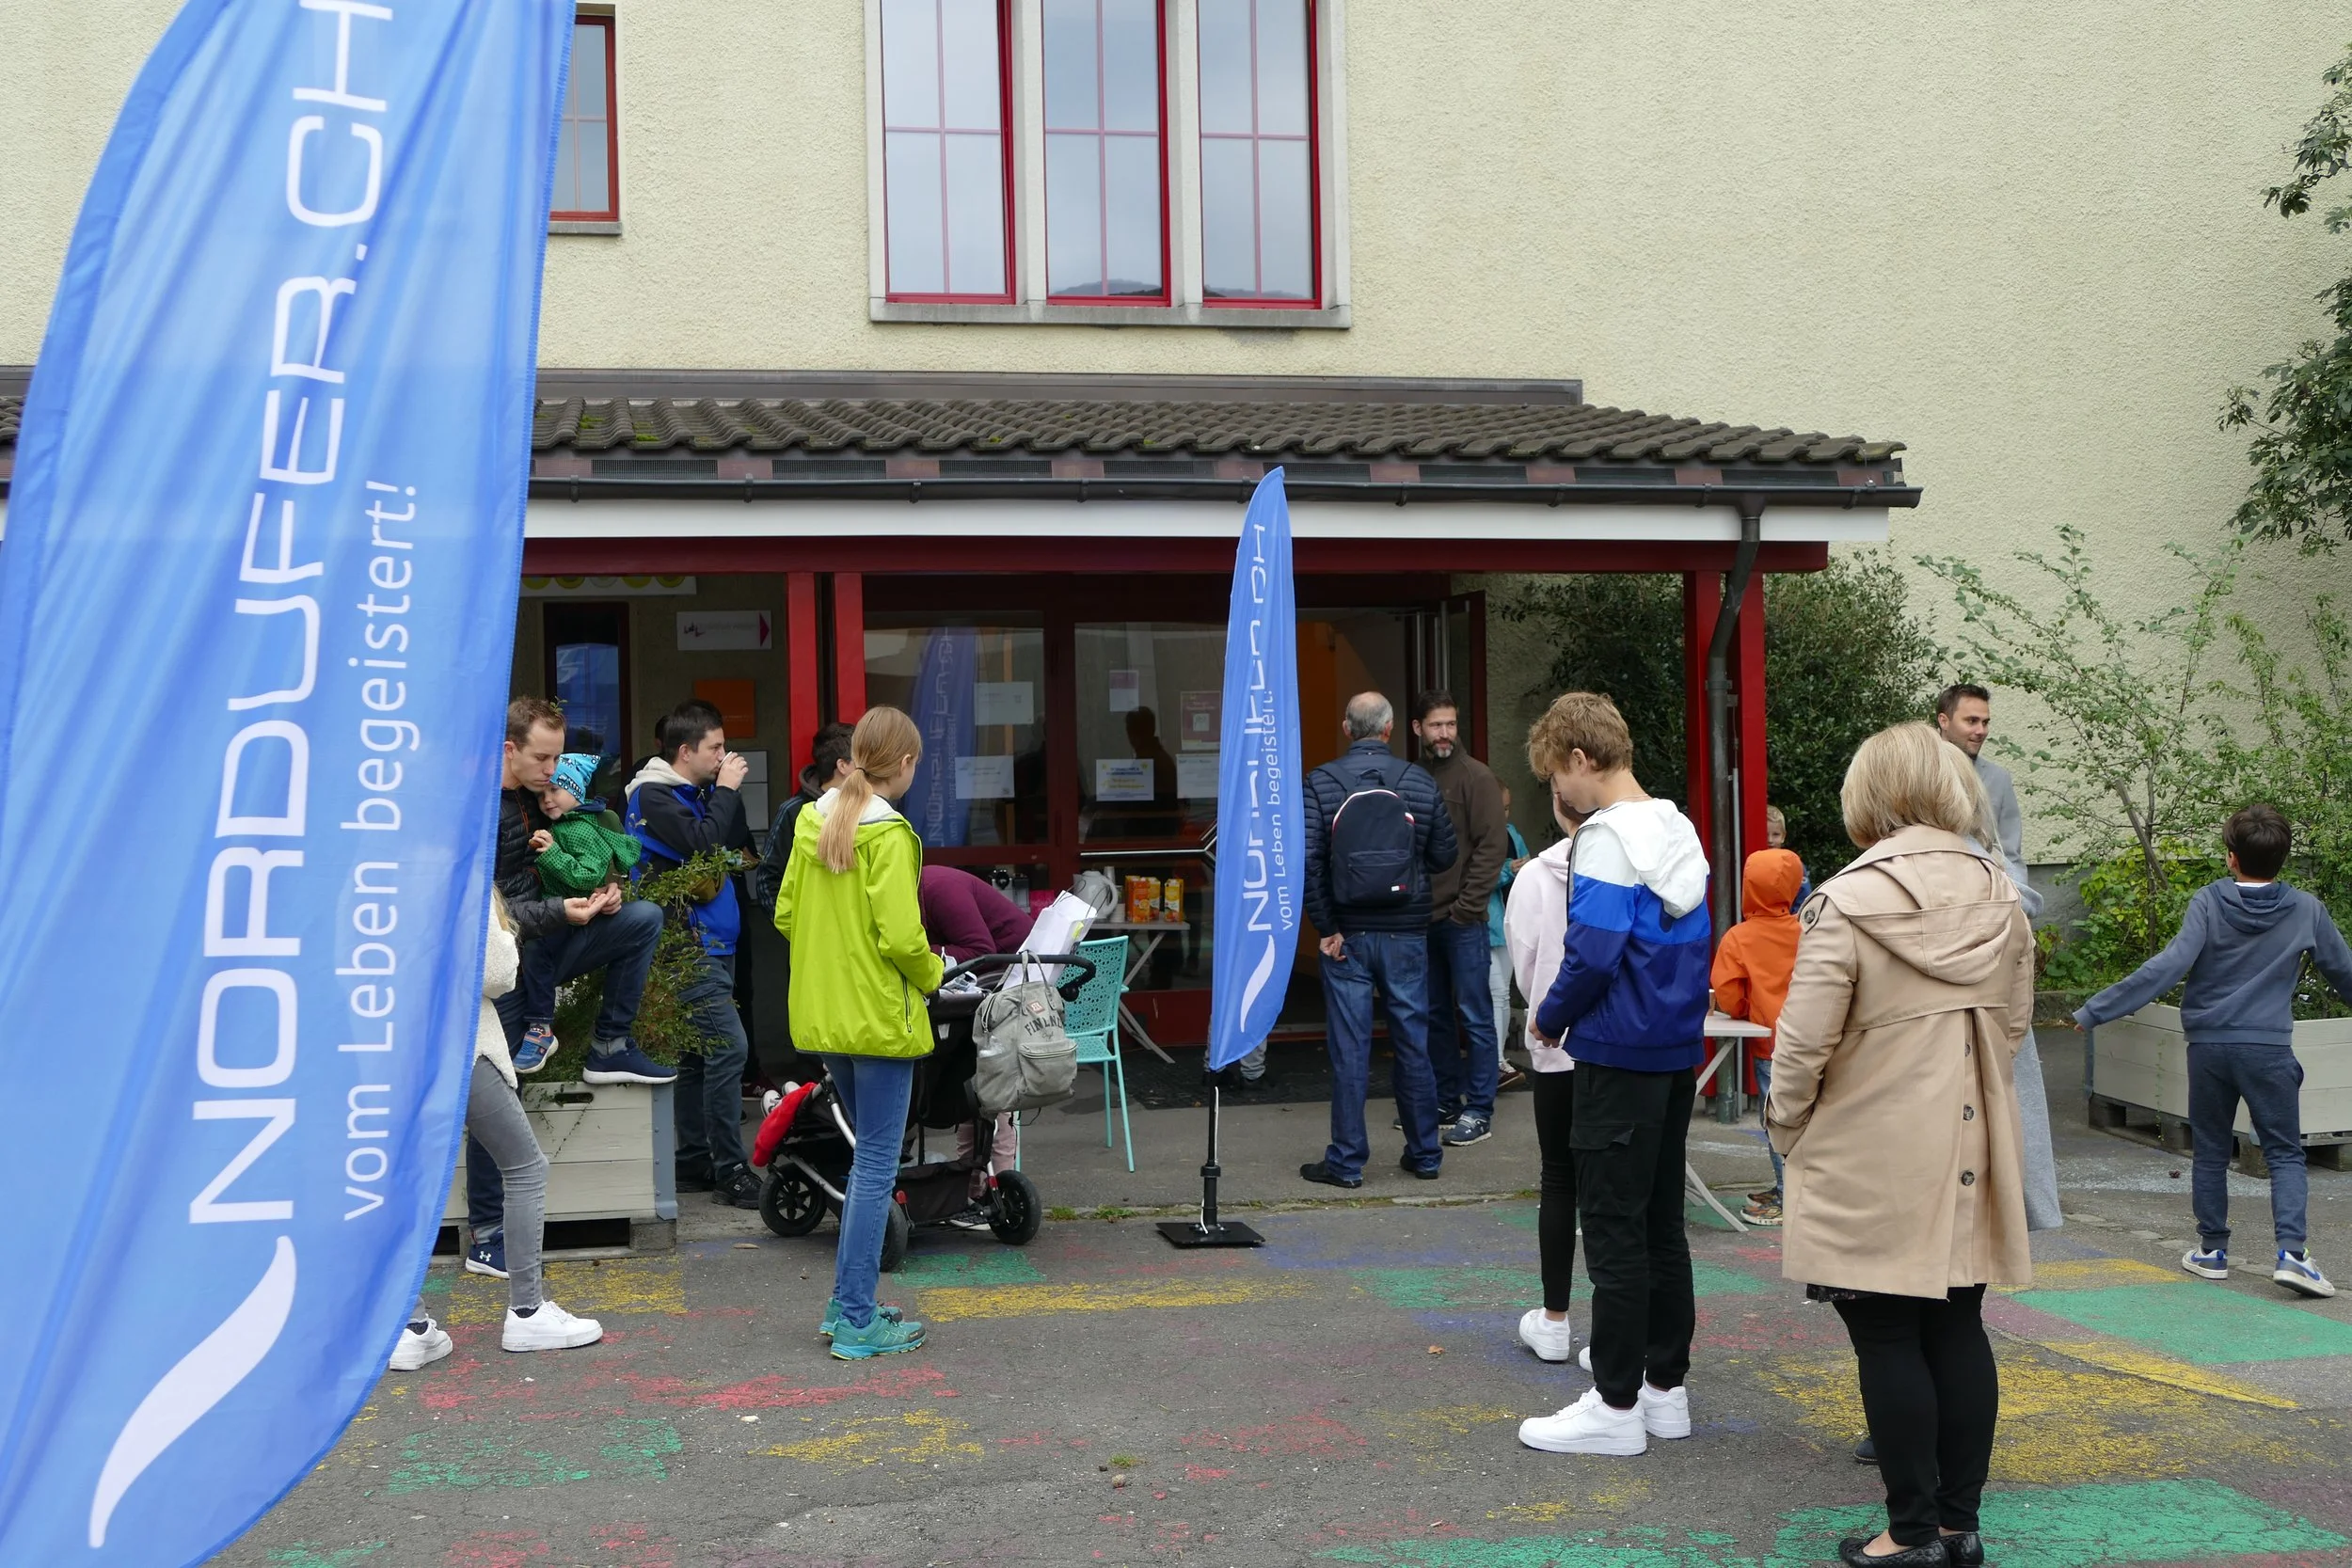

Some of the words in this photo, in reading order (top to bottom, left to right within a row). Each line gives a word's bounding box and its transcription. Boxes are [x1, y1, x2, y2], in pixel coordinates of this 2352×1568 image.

[188, 0, 392, 1224] NORDUFER.CH
[341, 481, 420, 832] begeistert!
[1272, 814, 1286, 878] Leben
[1278, 886, 1294, 930] vom
[337, 861, 400, 1053] Leben
[344, 1084, 391, 1221] vom
